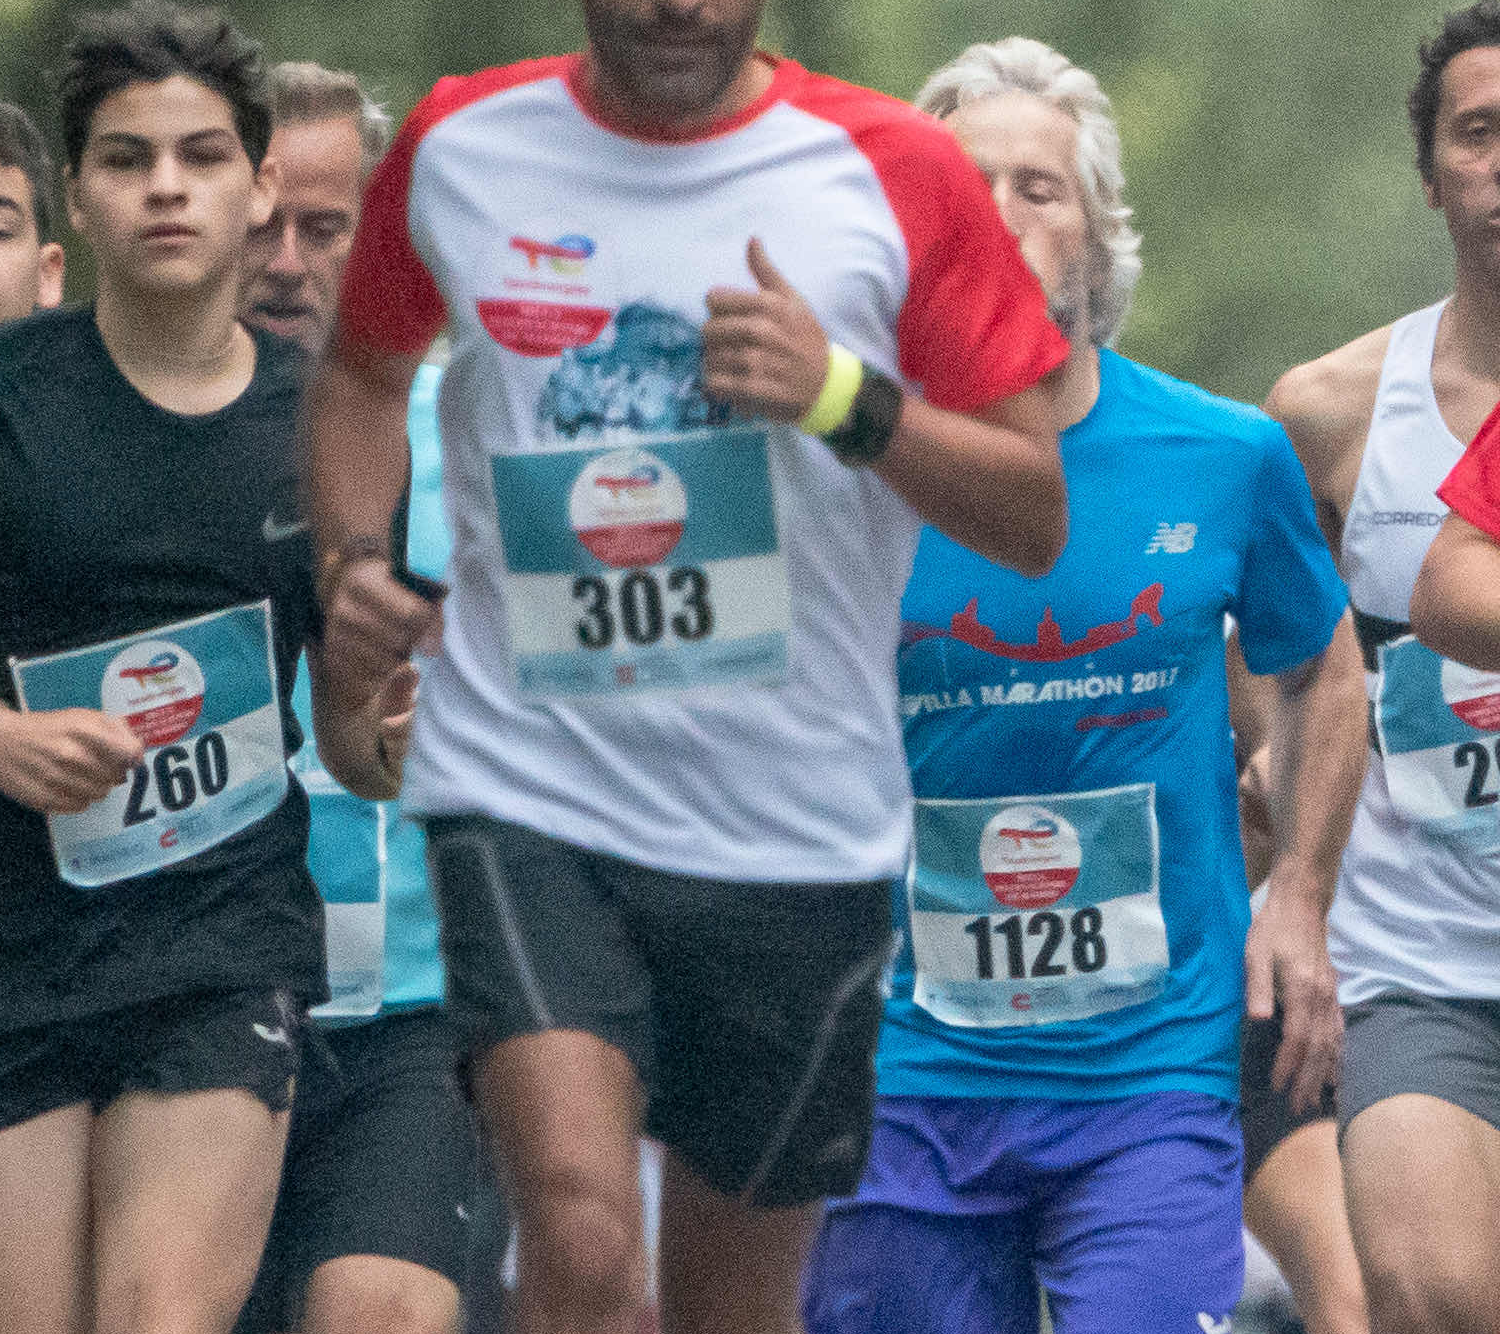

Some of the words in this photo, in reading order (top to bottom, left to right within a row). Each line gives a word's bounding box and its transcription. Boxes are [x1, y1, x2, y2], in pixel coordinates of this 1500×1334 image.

[571, 565, 715, 651] 303
[980, 674, 1124, 706] MARATHON
[1130, 666, 1180, 694] 2017
[122, 730, 229, 828] 260
[964, 907, 1108, 980] 1128
